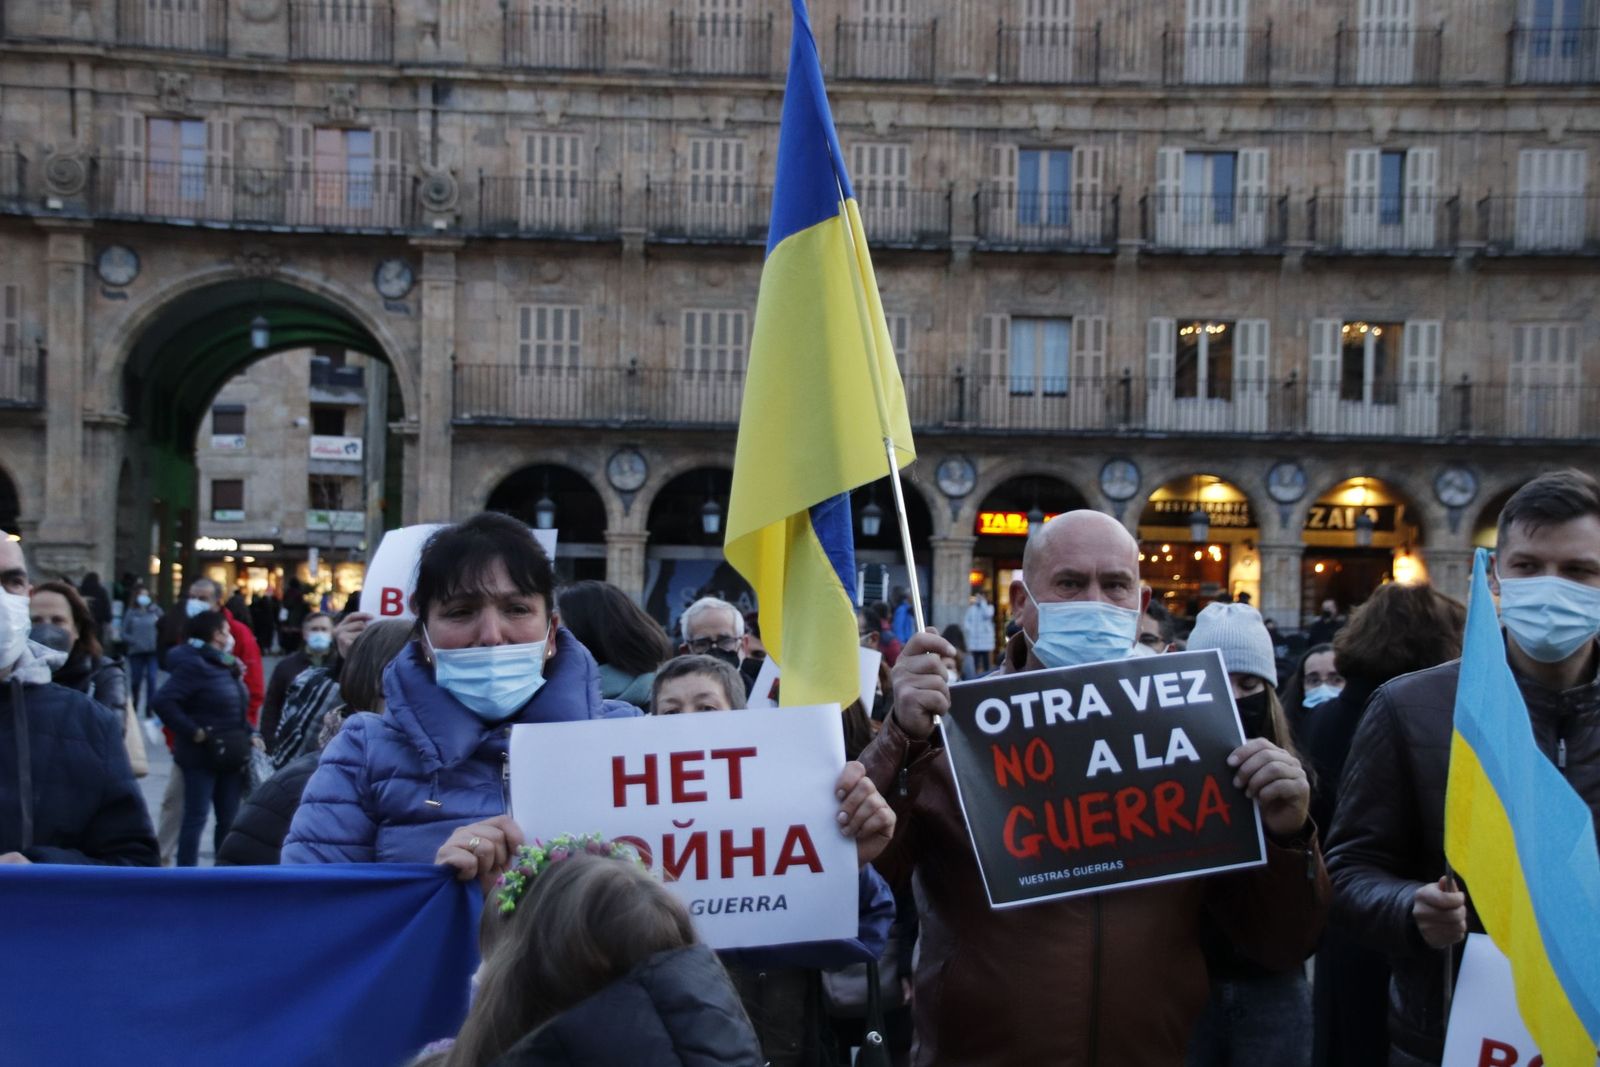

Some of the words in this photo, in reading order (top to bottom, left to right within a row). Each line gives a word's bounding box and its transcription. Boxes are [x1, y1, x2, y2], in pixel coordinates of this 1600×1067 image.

[1303, 507, 1379, 529] ZALO
[974, 683, 1112, 734] OTRA
[1119, 669, 1213, 711] VEZ
[611, 746, 758, 807] НЕТ
[990, 737, 1055, 788] NO
[1086, 739, 1122, 778] A
[1133, 727, 1200, 769] LA
[1002, 775, 1232, 860] GUERRA
[611, 818, 824, 883] ОЙНА
[1019, 869, 1070, 886] VUESTRAS
[1072, 860, 1124, 877] GUERRAS
[688, 894, 788, 916] GUERRA
